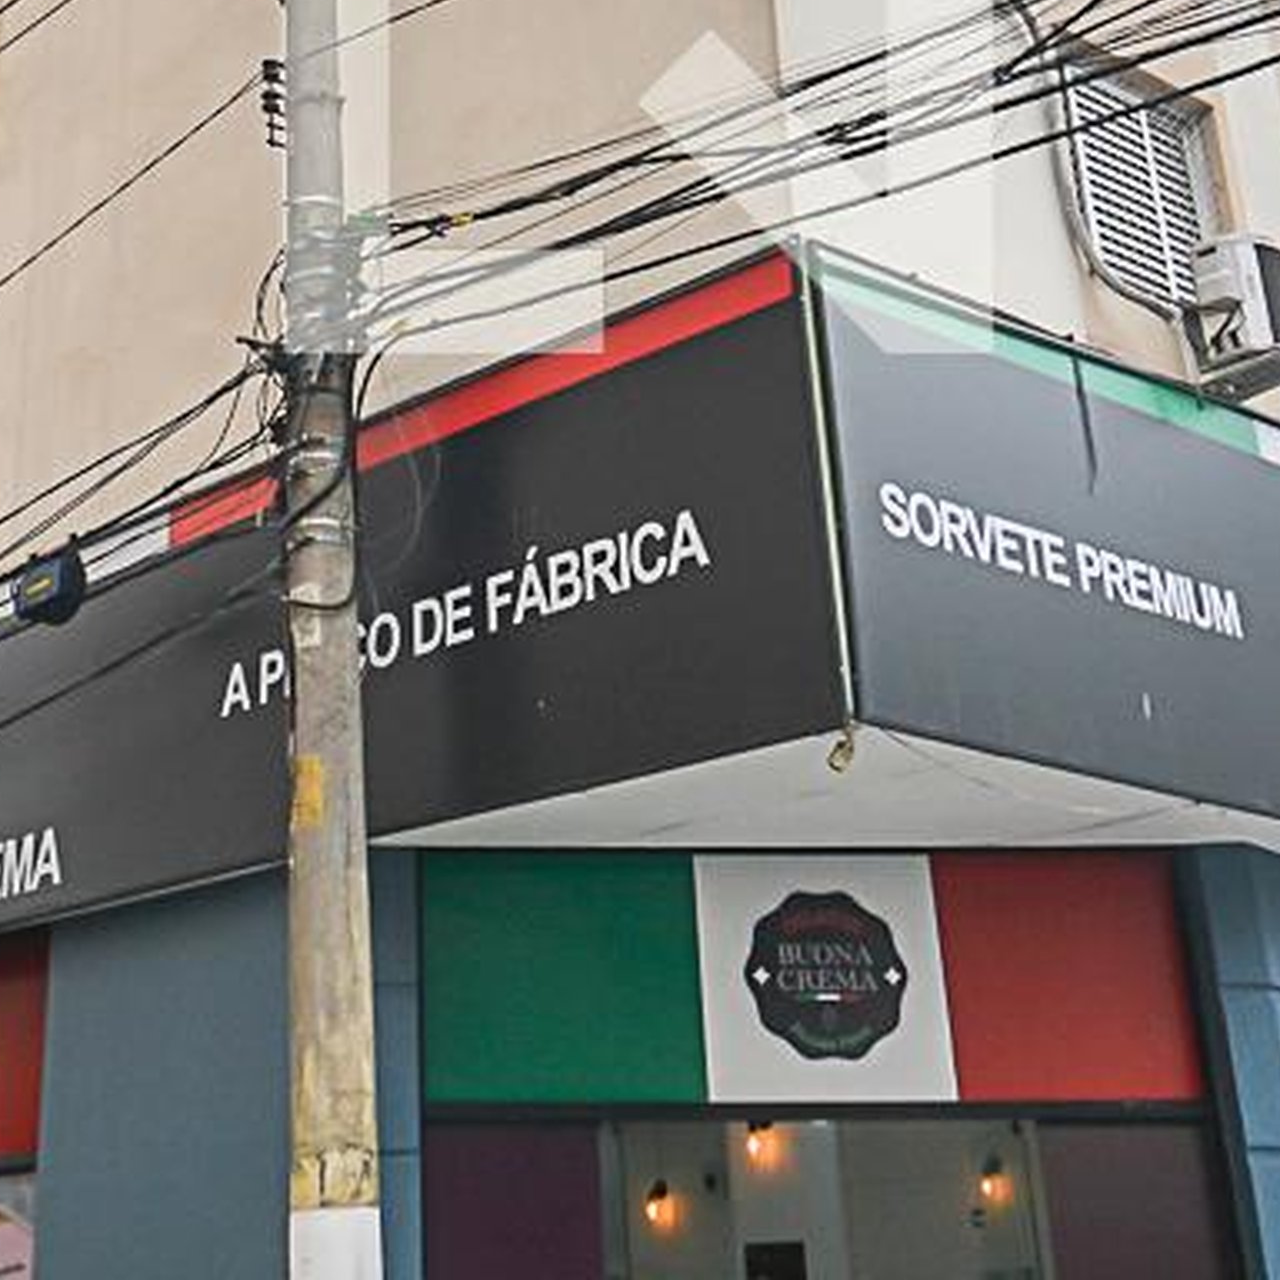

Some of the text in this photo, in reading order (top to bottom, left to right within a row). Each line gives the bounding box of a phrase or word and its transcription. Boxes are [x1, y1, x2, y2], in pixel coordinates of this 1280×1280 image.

[879, 483, 1245, 640] SORVETE PREMIUM
[220, 508, 710, 717] A DE FÁBRICA
[776, 966, 880, 992] CREMA
[777, 941, 875, 966] BUONA
